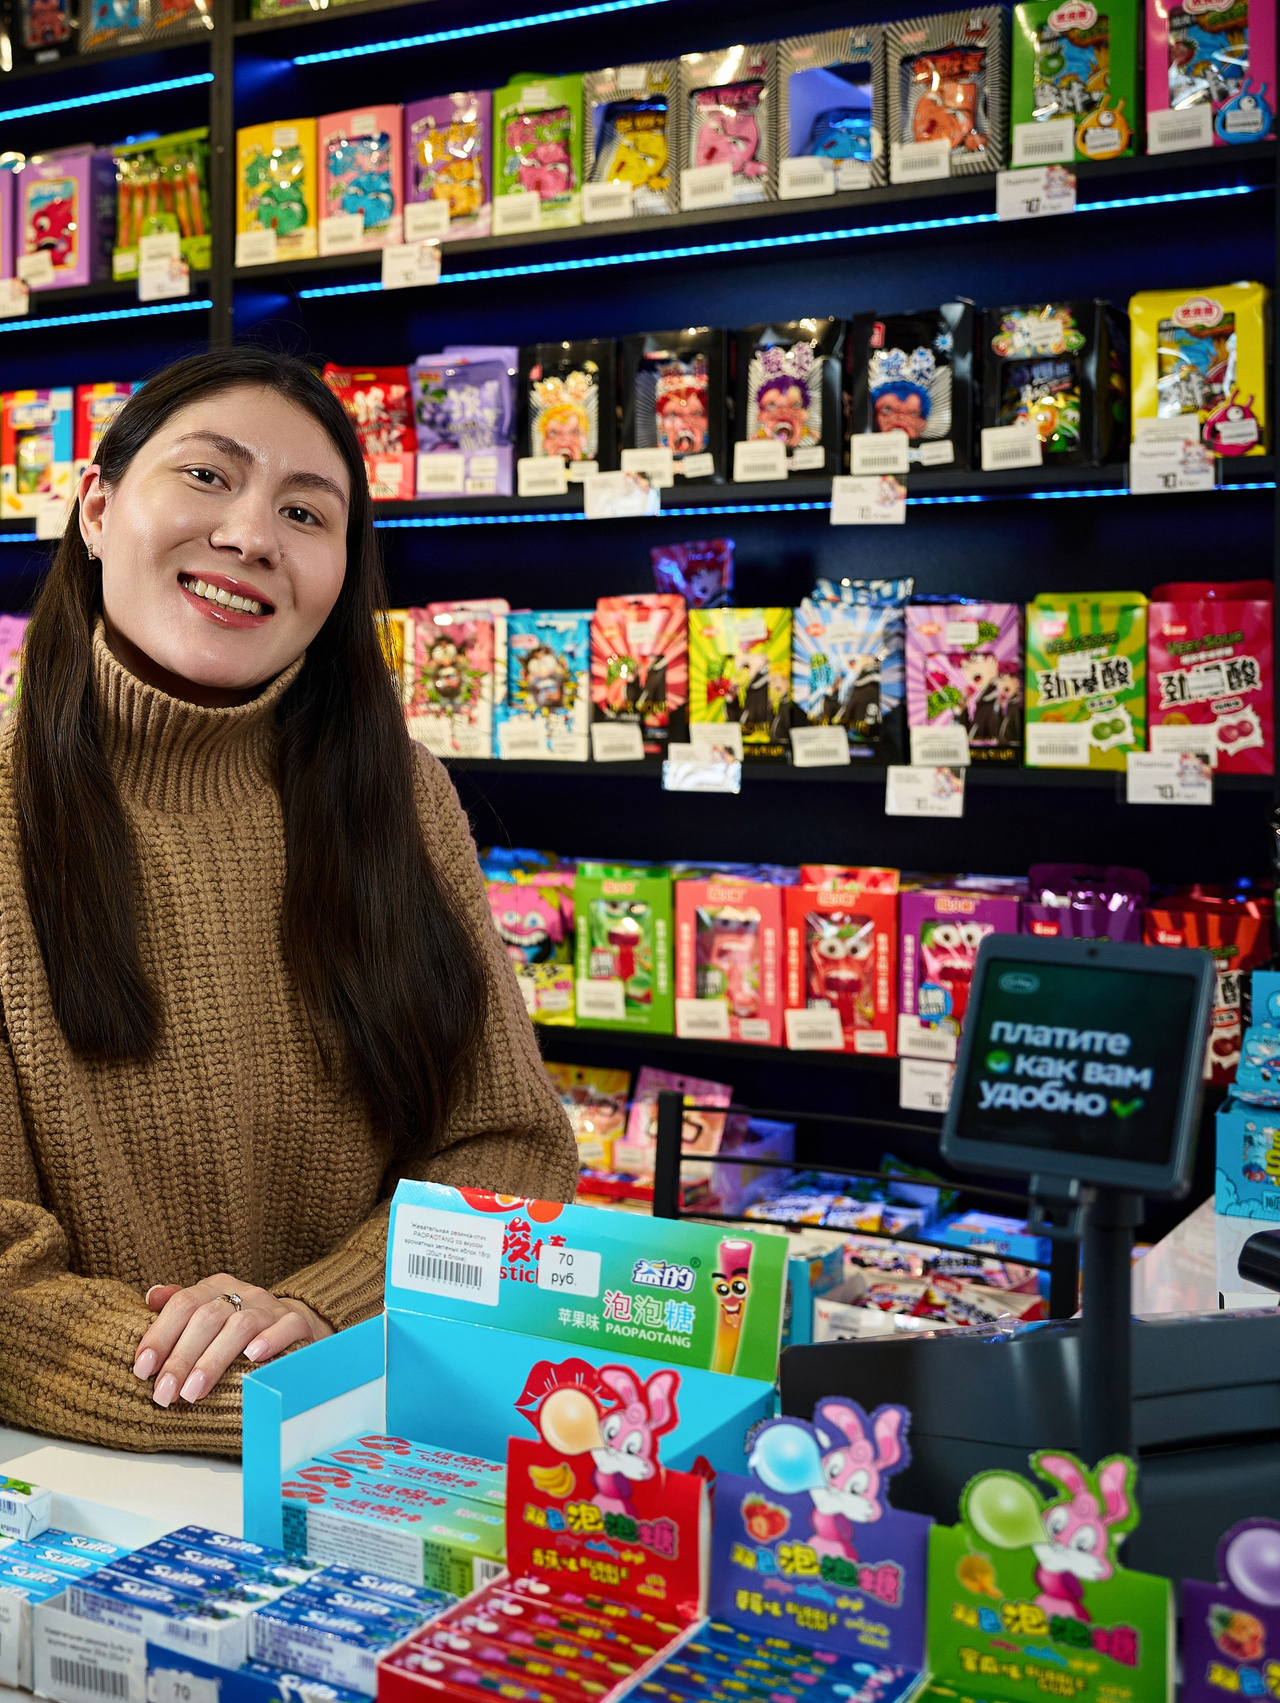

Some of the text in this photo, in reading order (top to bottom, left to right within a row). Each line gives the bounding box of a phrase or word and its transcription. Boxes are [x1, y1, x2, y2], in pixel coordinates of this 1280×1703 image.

[989, 1020, 1131, 1057] платите
[1014, 1053, 1152, 1091] как вам
[977, 1080, 1107, 1118] удобно
[411, 1222, 486, 1242] Жевательная резинка-стик
[413, 1231, 454, 1244] PAOPAOTANG
[464, 1240, 483, 1249] вкусом
[404, 1238, 434, 1249] ароматных
[435, 1244, 459, 1253] зеленых
[460, 1248, 476, 1257] яблок
[426, 1249, 442, 1258] (20шт
[448, 1253, 467, 1263] блоке)
[558, 1252, 574, 1266] 70
[551, 1271, 577, 1286] руб.
[632, 1259, 695, 1293] 益的
[558, 1307, 600, 1331] 苹果味
[603, 1290, 696, 1333] 泡泡糖
[605, 1323, 692, 1349] PAOPAOTANG
[173, 1681, 191, 1700] 70
